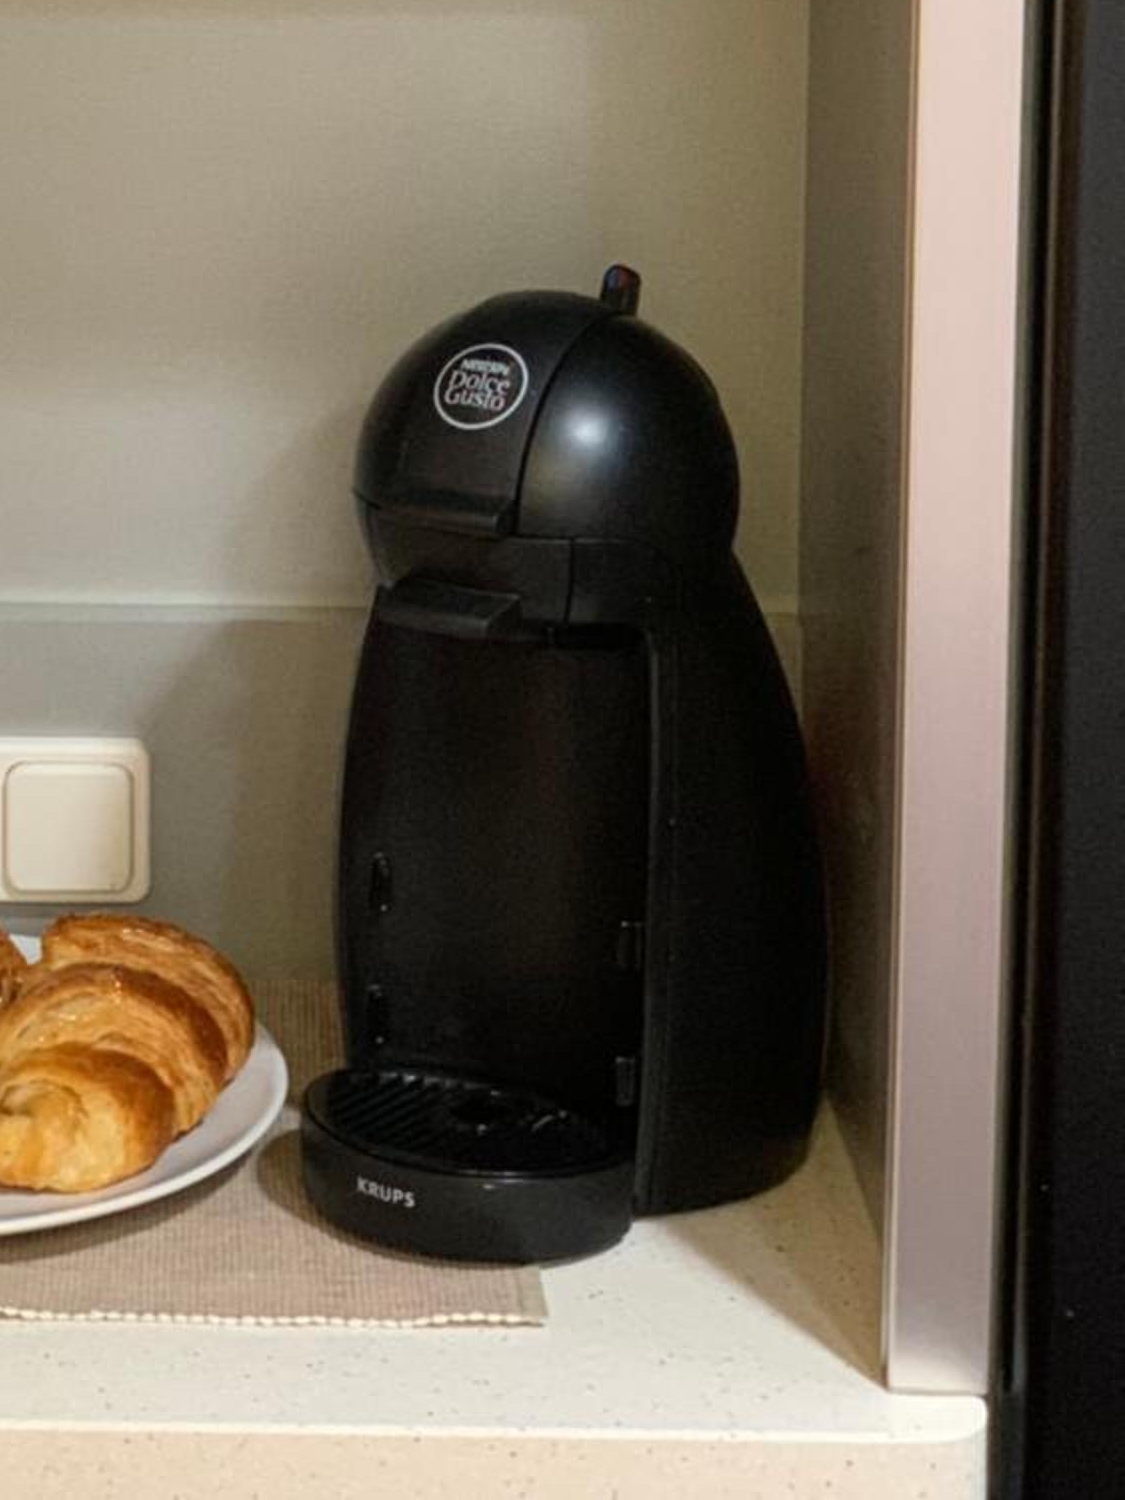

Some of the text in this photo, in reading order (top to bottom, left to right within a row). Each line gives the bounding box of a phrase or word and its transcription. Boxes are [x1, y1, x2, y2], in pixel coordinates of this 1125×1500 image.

[449, 370, 510, 395] Dolce
[444, 387, 506, 411] Gusto
[356, 1176, 416, 1209] KRUPS
